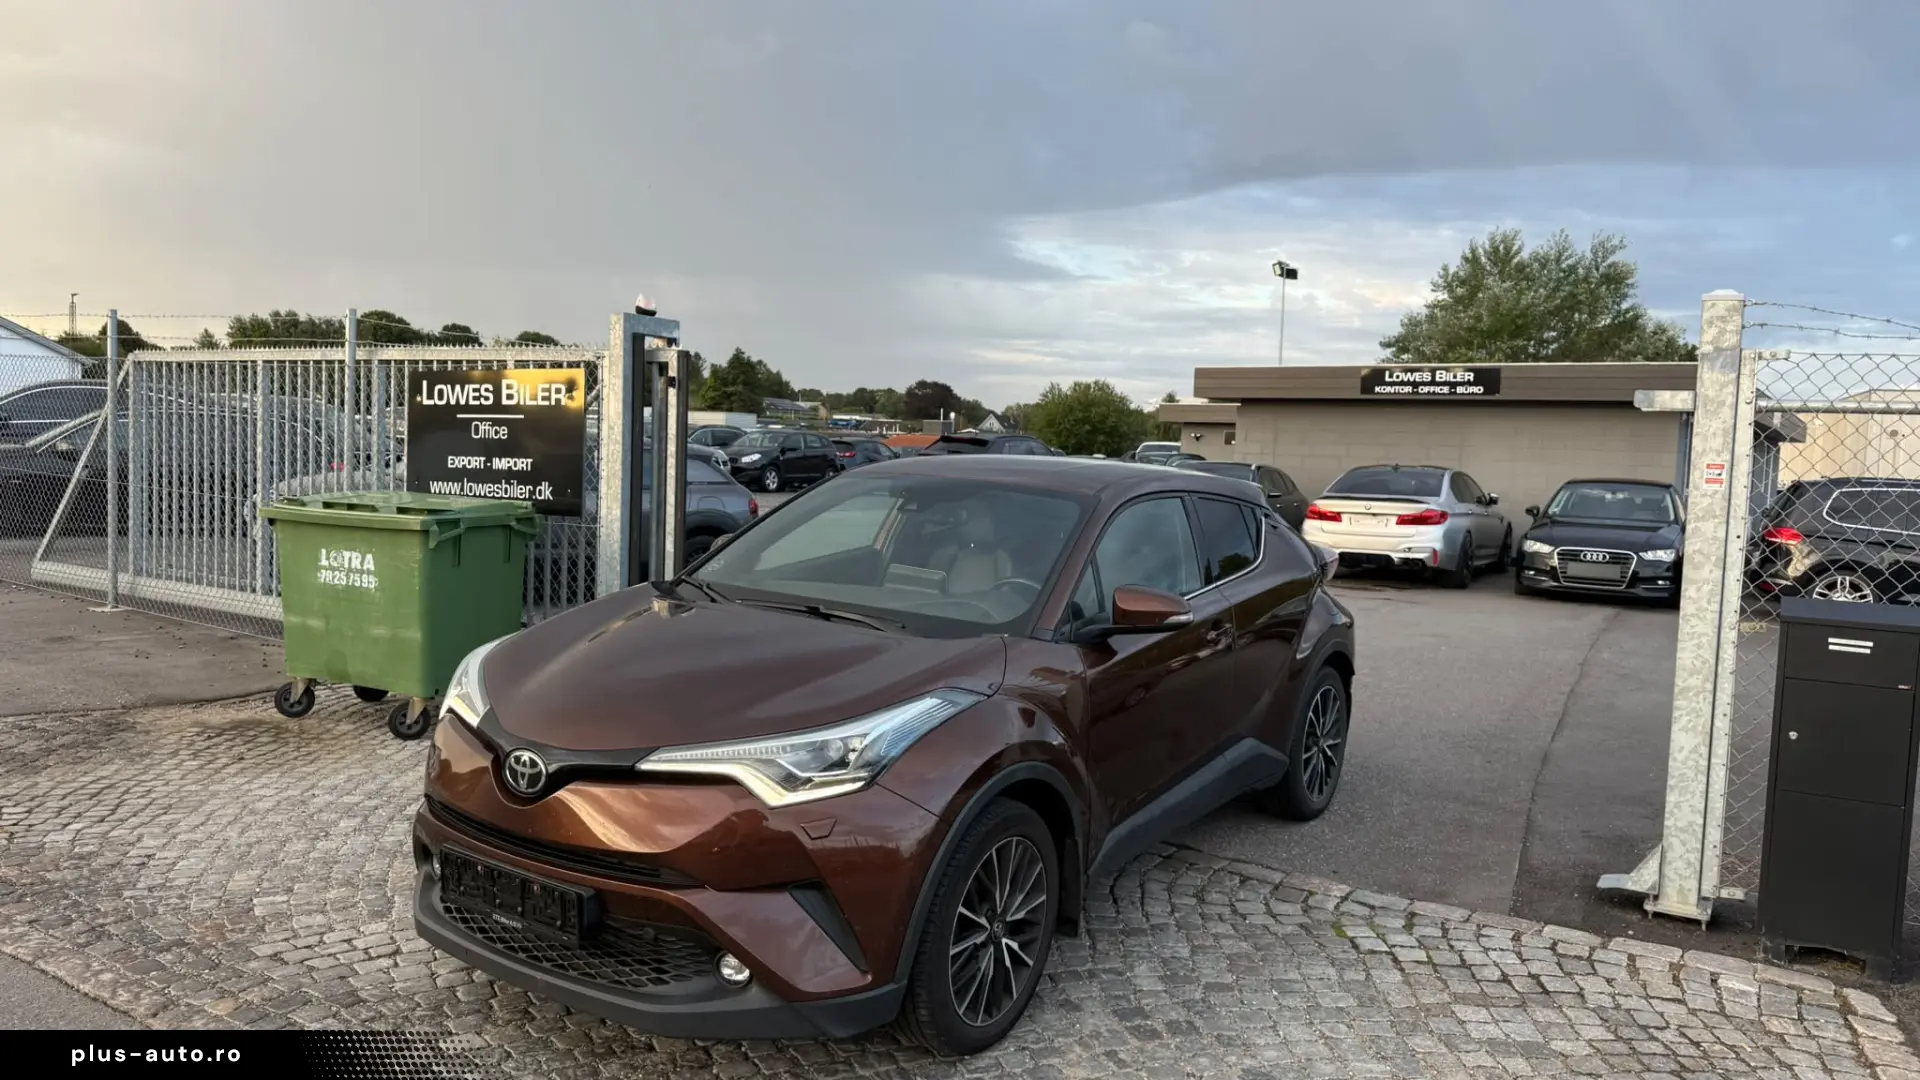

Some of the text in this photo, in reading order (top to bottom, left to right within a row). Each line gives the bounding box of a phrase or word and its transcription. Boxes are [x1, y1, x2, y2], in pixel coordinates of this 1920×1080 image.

[1384, 370, 1475, 382] LOWES BILER
[422, 379, 567, 406] LOWES BILER
[1374, 385, 1412, 394] KONTOR
[1418, 385, 1450, 394] OFFICE
[1456, 384, 1484, 394] BÜRO
[471, 421, 508, 440] Office
[447, 456, 486, 469] EXPORT
[492, 457, 533, 471] IMPORT
[429, 478, 554, 501] www.lowesbiler.dk
